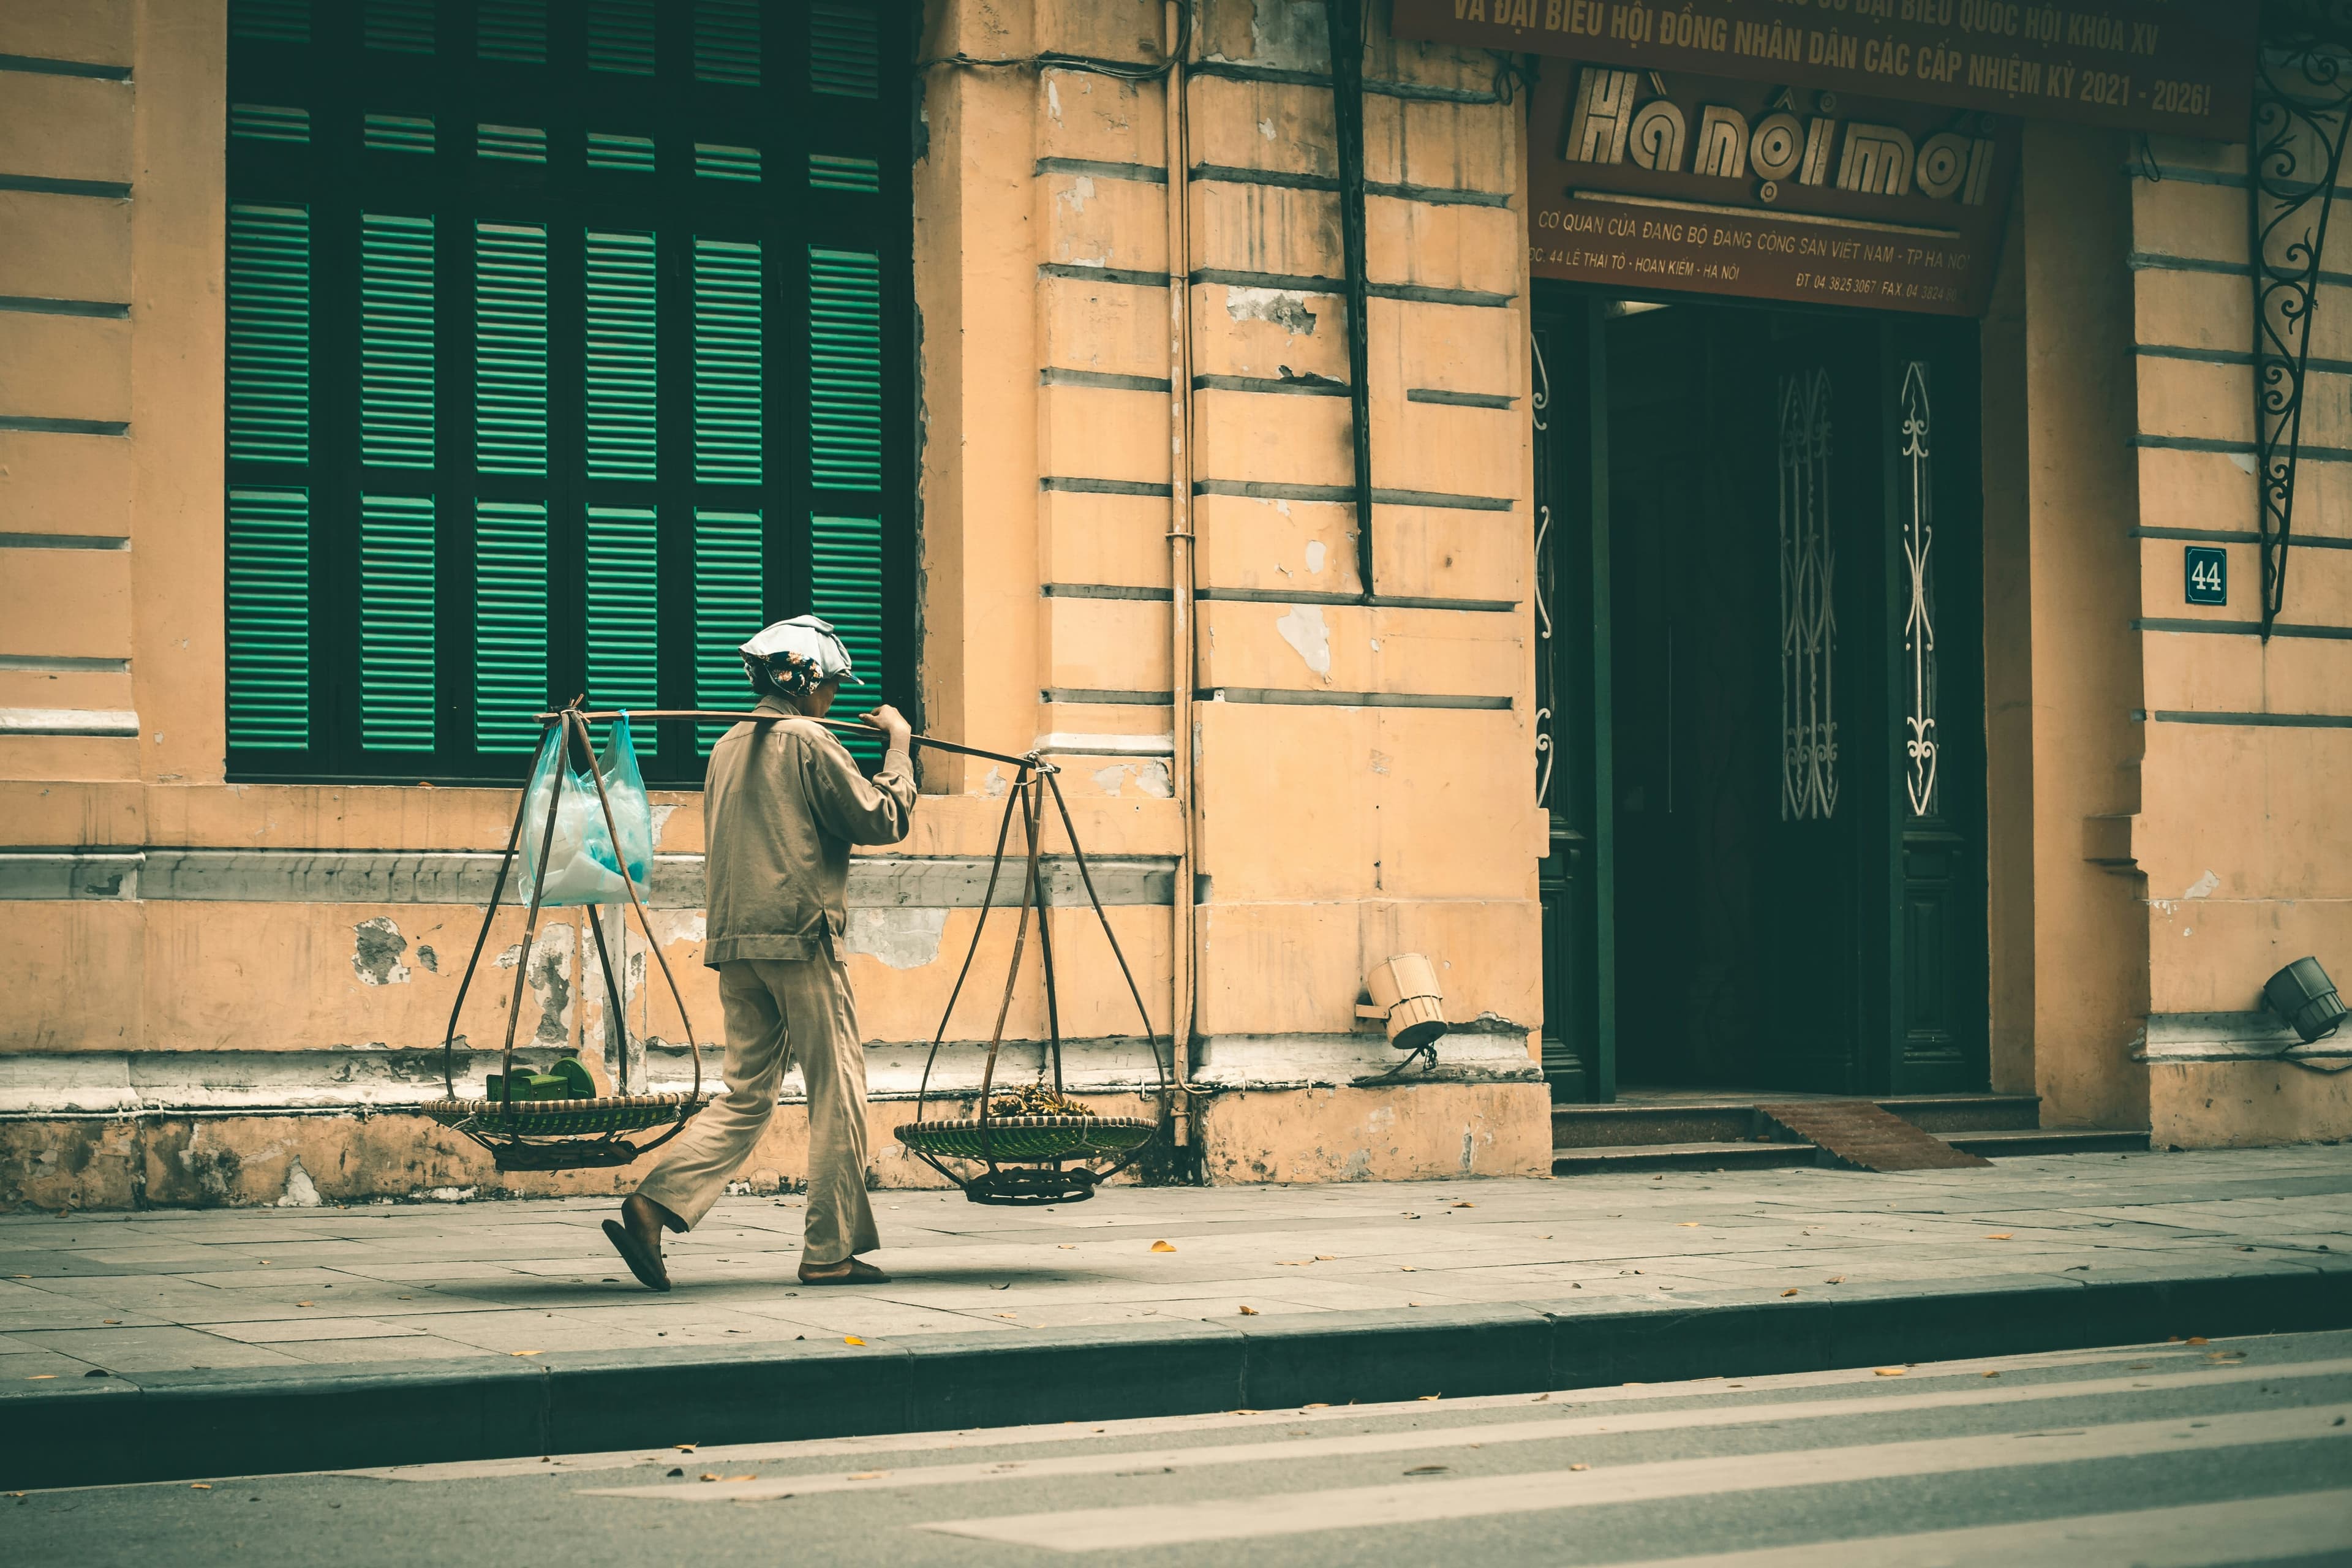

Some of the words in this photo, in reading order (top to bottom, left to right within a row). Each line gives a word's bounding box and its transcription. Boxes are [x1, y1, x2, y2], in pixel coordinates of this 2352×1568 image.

[2131, 21, 2160, 56] XV
[1610, 1, 1653, 48] HỘI
[1734, 19, 1802, 62] NHÂN
[1808, 26, 1858, 69] DÂN
[1864, 34, 1910, 76] CÁC
[1917, 37, 1961, 82] CẤP
[1968, 52, 2042, 99] NHIỆM
[2080, 69, 2131, 107] 2021
[2152, 78, 2211, 116] 2026!
[1566, 67, 1686, 172] Hà
[1694, 85, 1836, 203] nội
[1550, 249, 1564, 264] 44
[1566, 247, 1582, 266] LÊ
[1563, 214, 1605, 235] QUAN
[1608, 213, 1637, 238] CỦA
[1863, 244, 1895, 263] NAM
[1907, 247, 1923, 266] TP
[1829, 276, 1853, 292] 3825
[2192, 560, 2222, 591] 44
